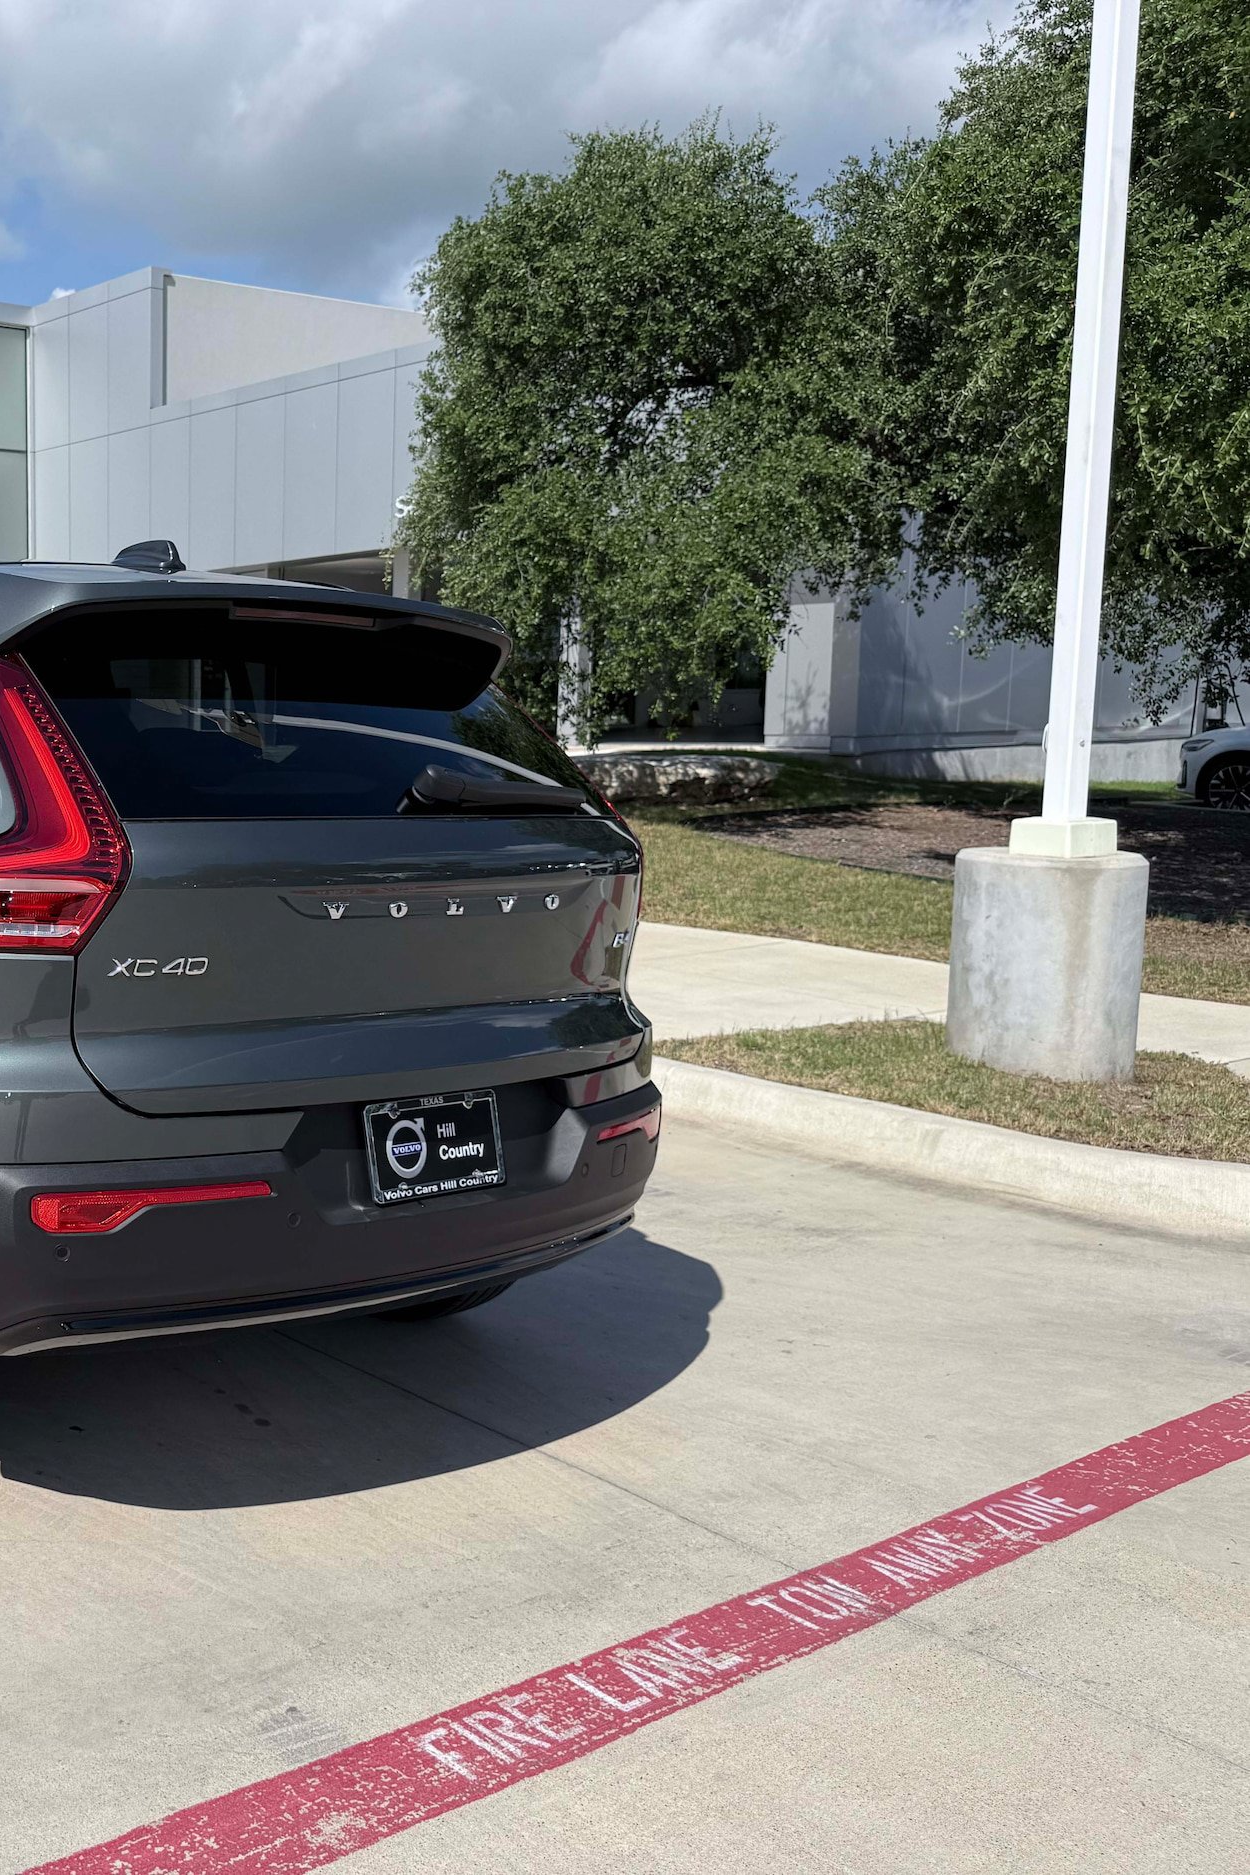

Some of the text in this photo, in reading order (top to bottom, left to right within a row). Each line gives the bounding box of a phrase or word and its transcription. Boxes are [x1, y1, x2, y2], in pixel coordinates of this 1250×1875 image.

[323, 894, 560, 920] VOLVO
[107, 957, 209, 977] XC40
[419, 1096, 444, 1107] TEXAS
[437, 1122, 457, 1139] Hill
[393, 1143, 422, 1155] VOLVO
[439, 1141, 484, 1160] Country
[384, 1173, 498, 1201] Volvo Cars Hill Country
[416, 1485, 1099, 1782] FIRE LANE TOW AWAY ZONE
